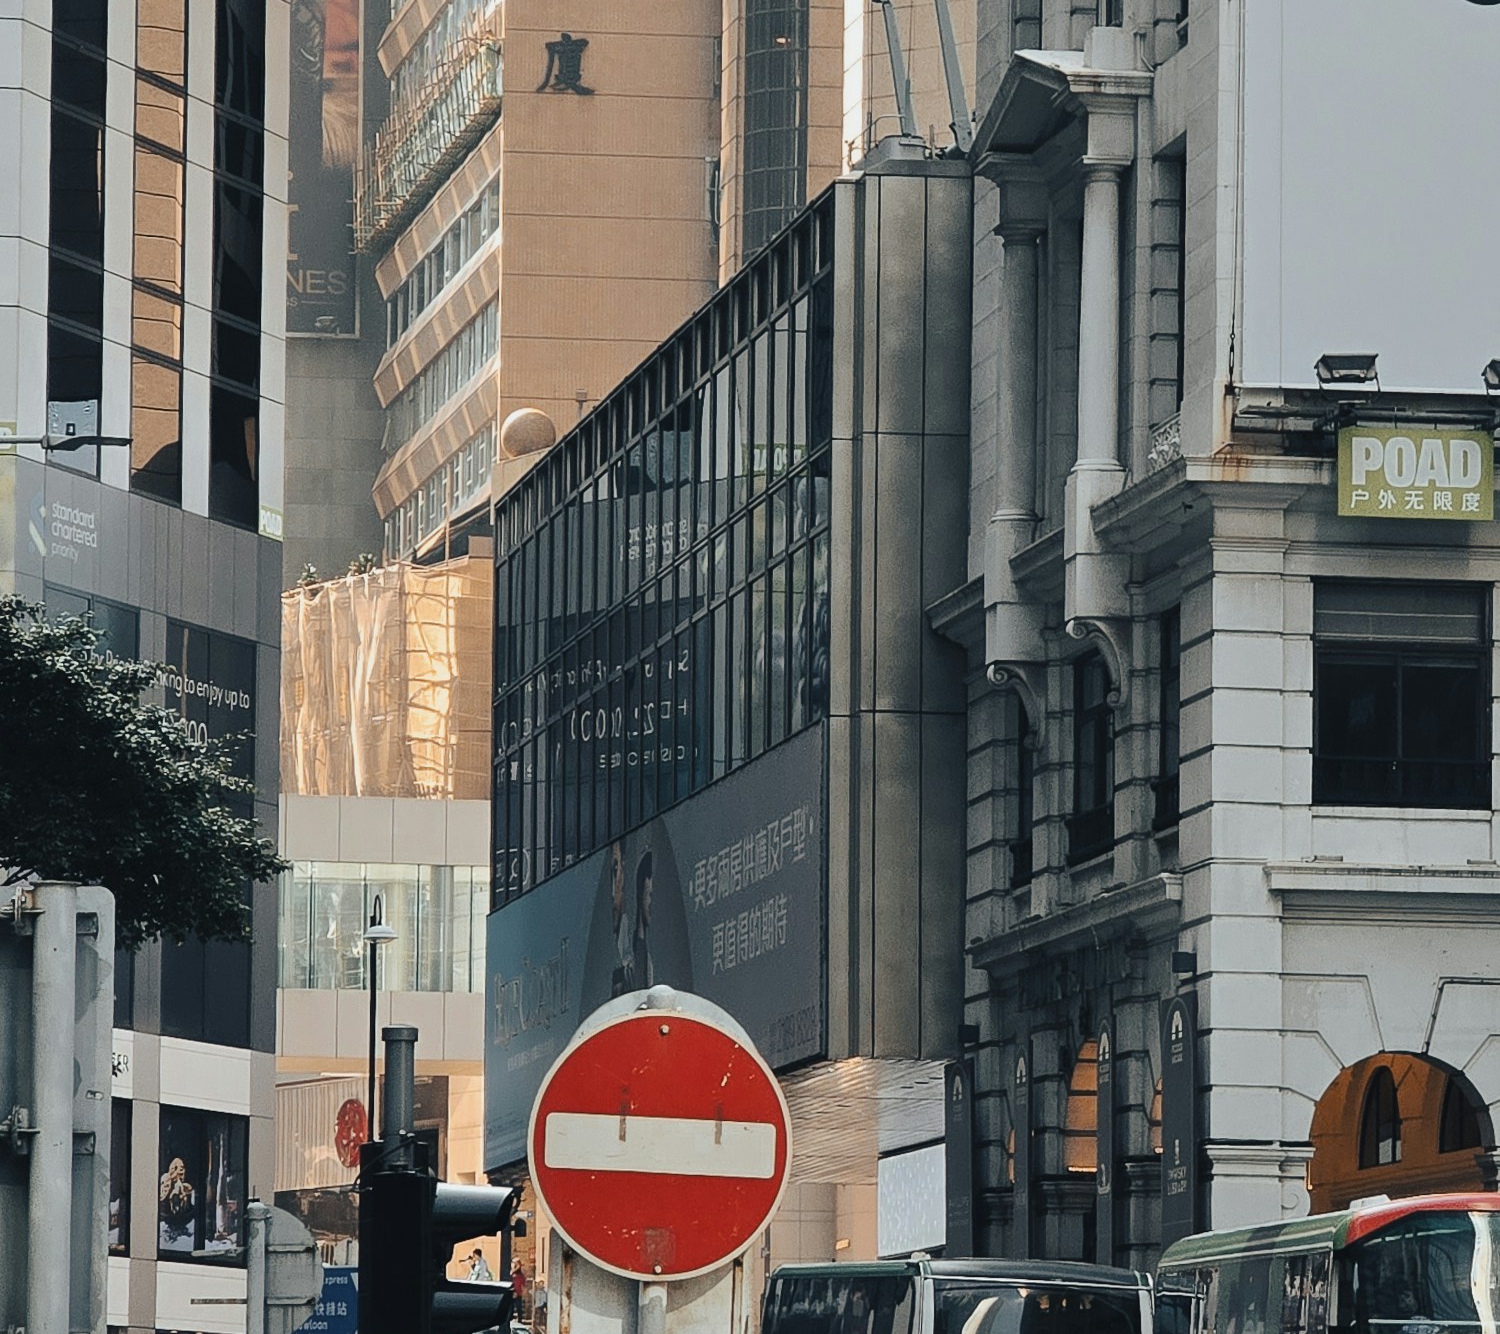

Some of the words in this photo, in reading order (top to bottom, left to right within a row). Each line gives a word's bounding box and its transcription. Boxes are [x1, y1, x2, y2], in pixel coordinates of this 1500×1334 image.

[1351, 436, 1482, 489] POAD
[51, 501, 95, 527] standard
[1351, 489, 1481, 512] 户外无限度
[51, 520, 97, 548] chartered
[51, 542, 79, 564] priority
[184, 675, 195, 695] to
[224, 689, 238, 710] up
[239, 689, 250, 709] to
